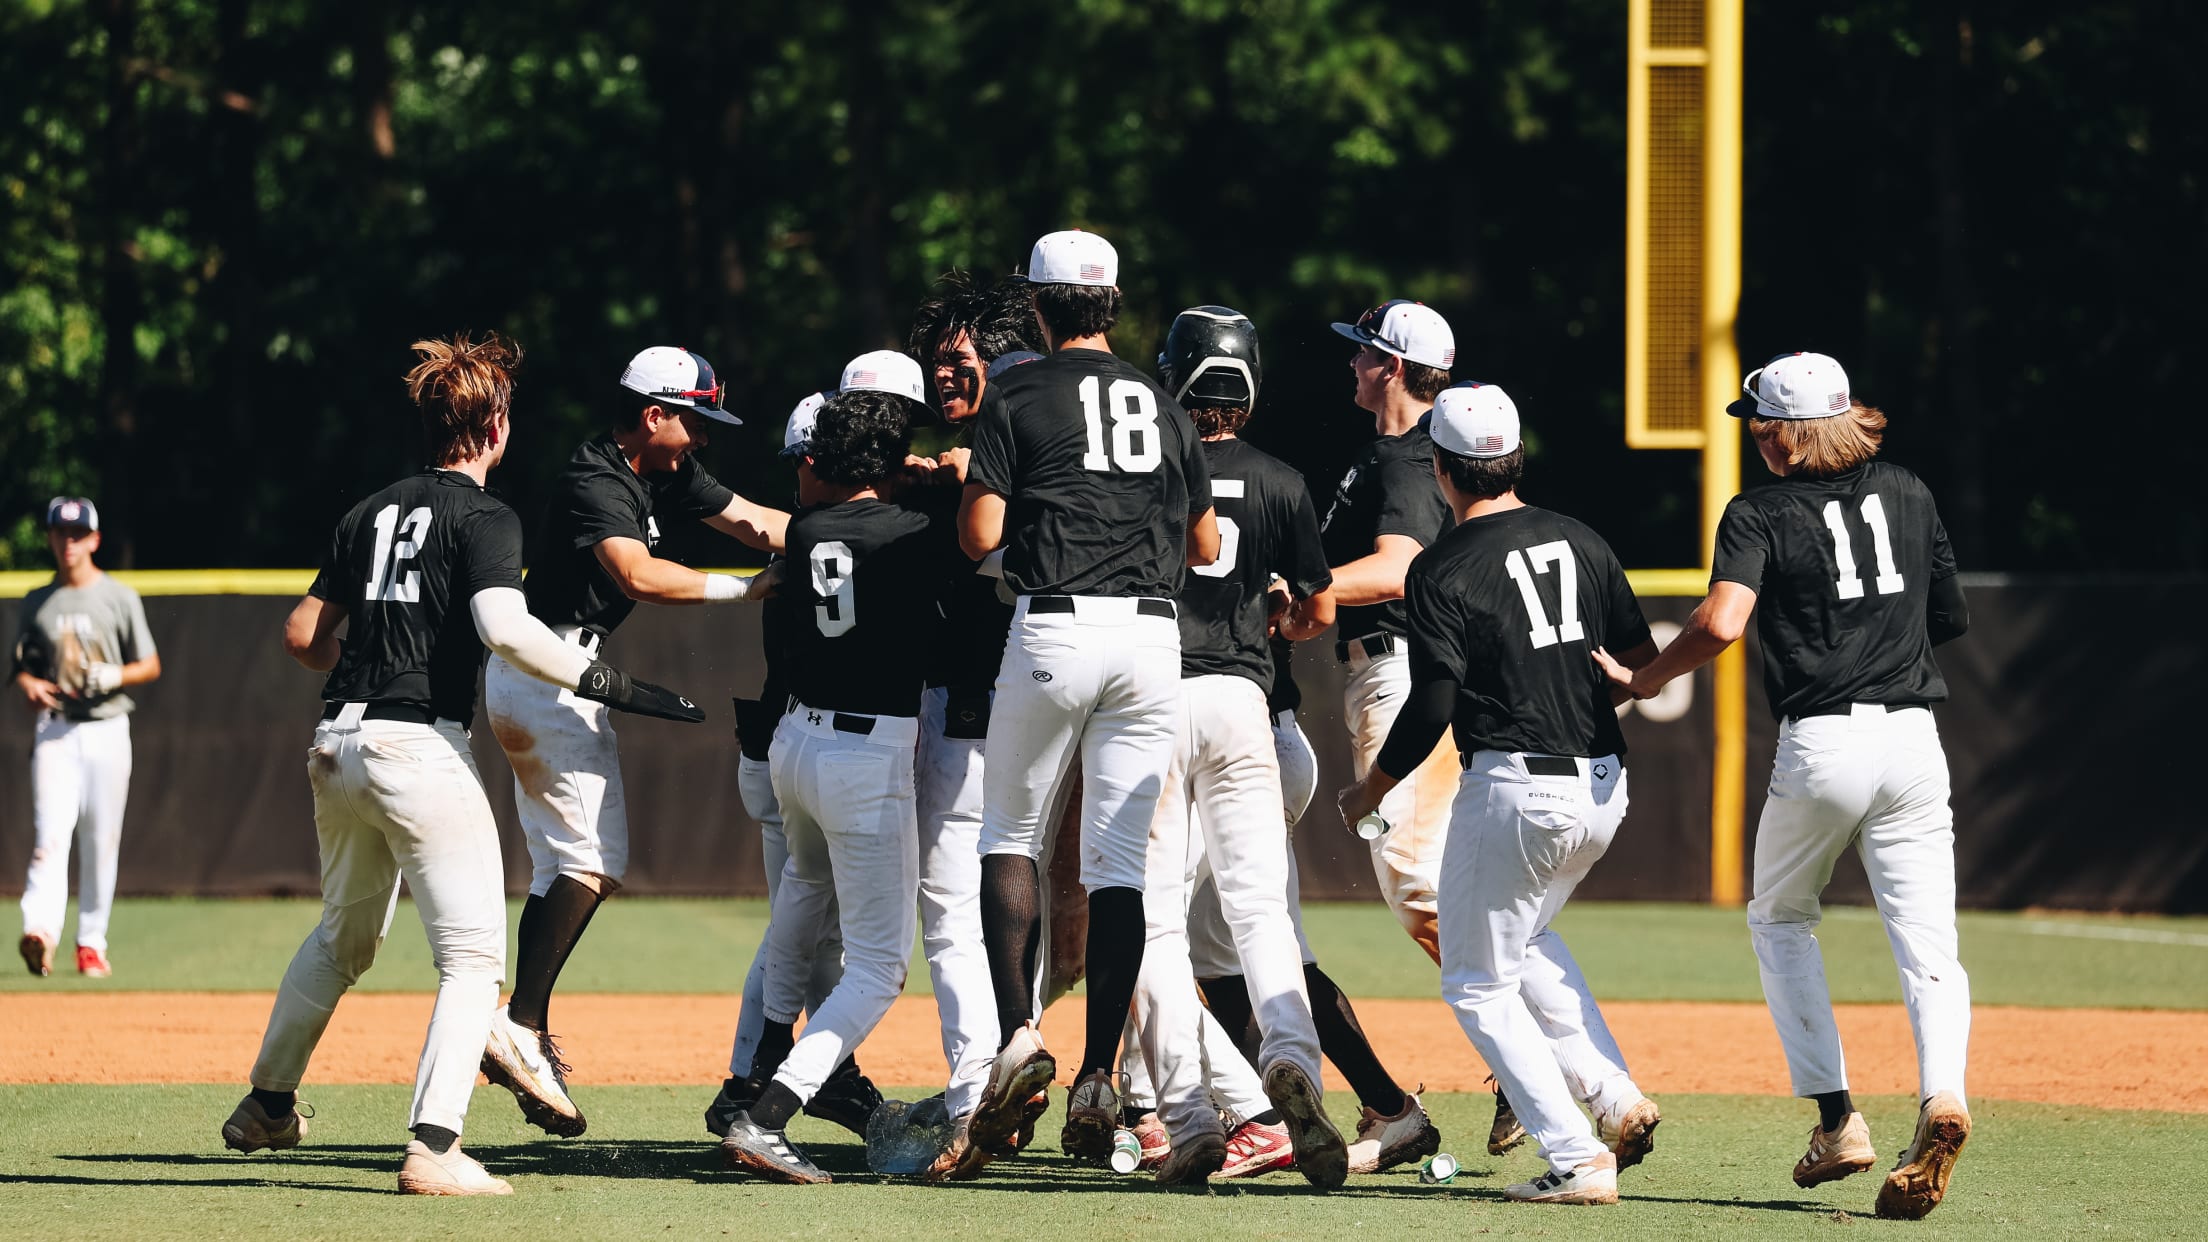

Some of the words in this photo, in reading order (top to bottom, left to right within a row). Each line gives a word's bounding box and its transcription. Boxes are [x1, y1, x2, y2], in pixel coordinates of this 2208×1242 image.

[1078, 375, 1162, 473] 18
[365, 503, 433, 602] 12
[810, 540, 857, 638] 9
[1504, 539, 1585, 649] 17
[1822, 492, 1905, 600] 11
